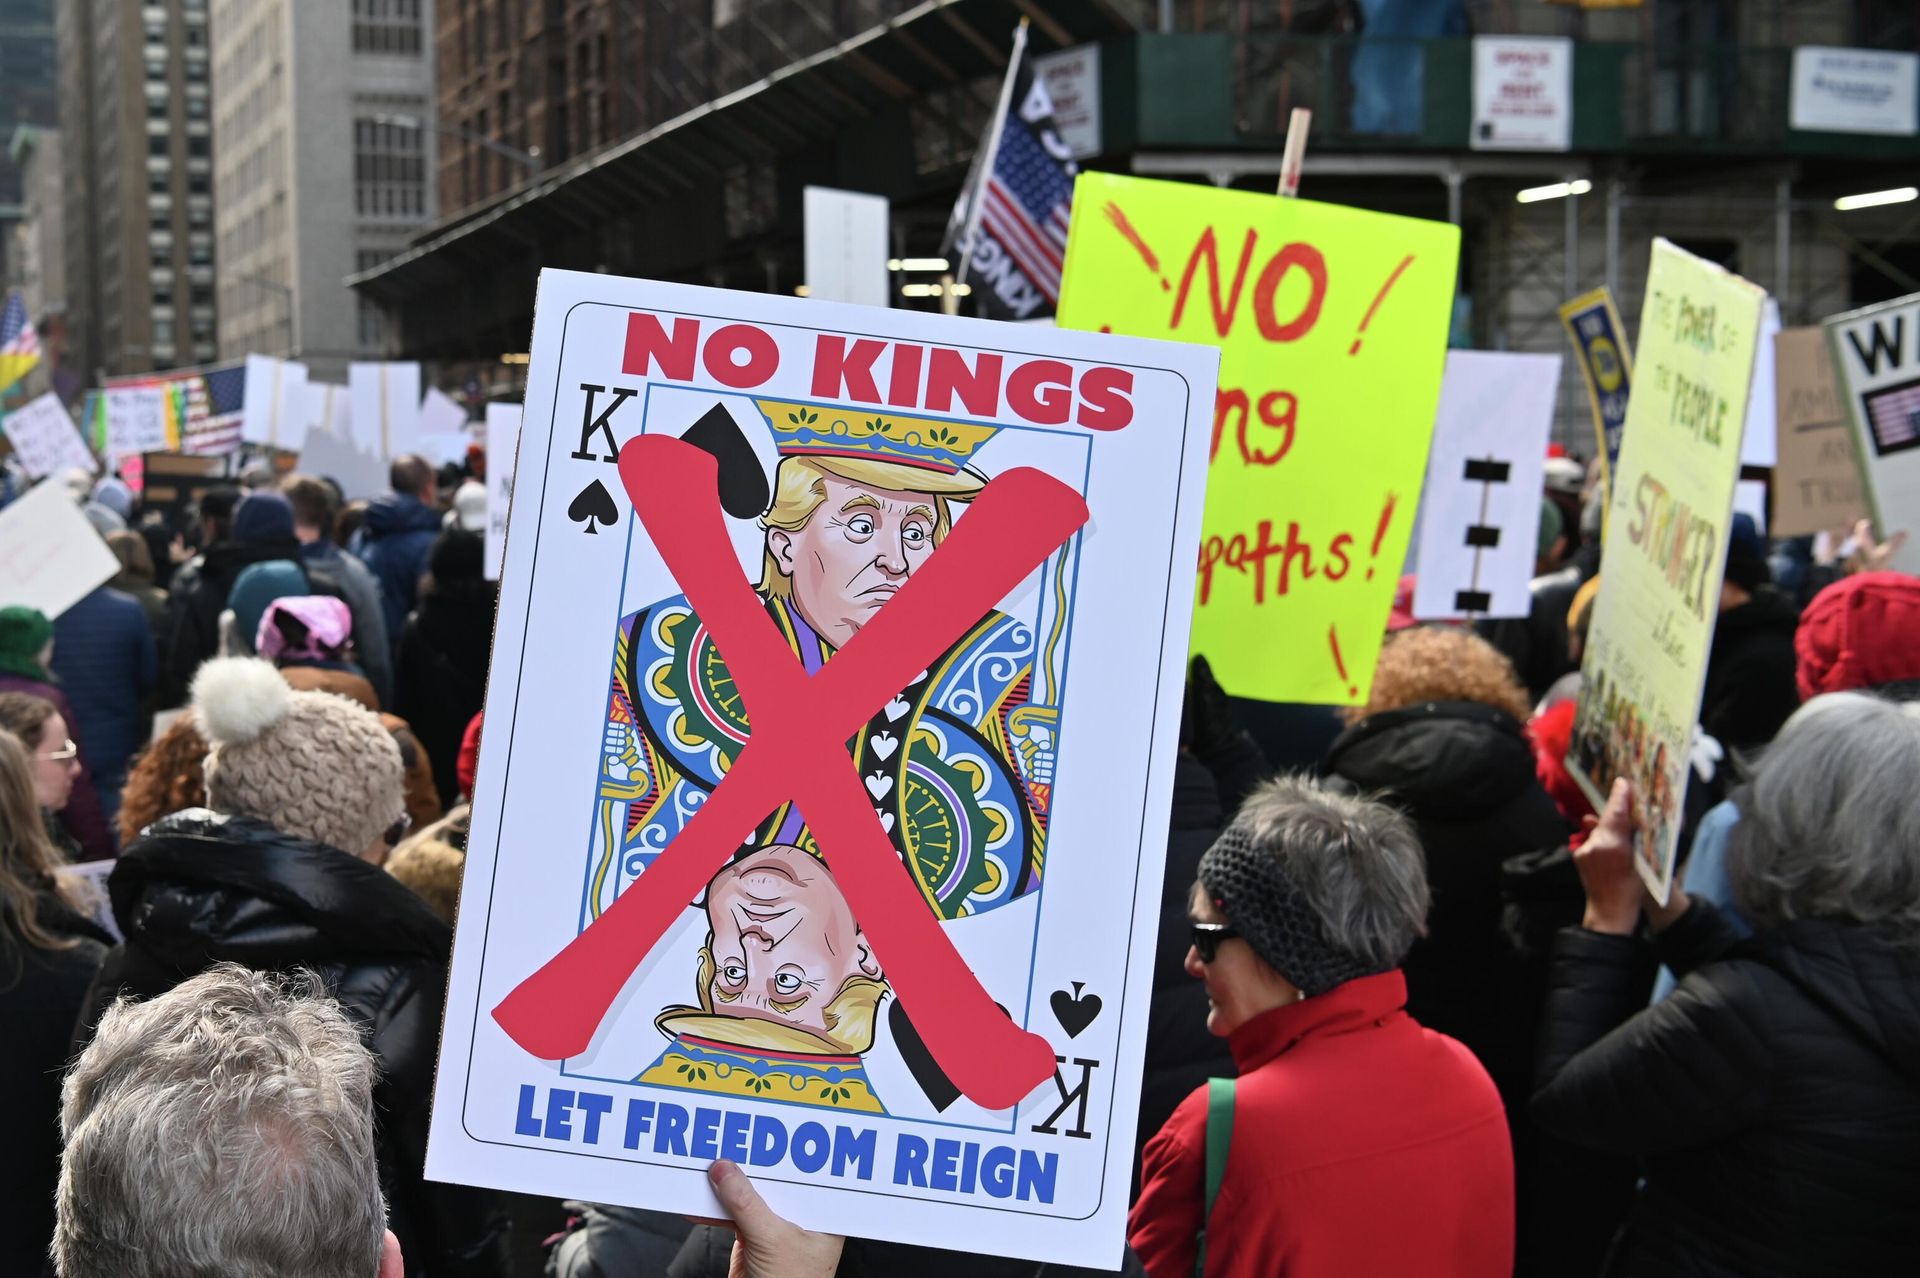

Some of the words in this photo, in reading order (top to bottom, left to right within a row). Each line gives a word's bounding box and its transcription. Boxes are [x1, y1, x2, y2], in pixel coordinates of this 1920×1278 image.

[1168, 223, 1329, 344] NO
[623, 312, 780, 389] NO
[812, 334, 1135, 432] KINGS
[1845, 310, 1920, 377] W
[571, 383, 638, 465] K
[1208, 387, 1299, 468] ng
[1197, 490, 1397, 606] paths!
[515, 1084, 614, 1145] LET
[623, 1098, 878, 1181] FREEDOM
[892, 1133, 1059, 1204] REIGN
[1031, 1054, 1100, 1140] K
